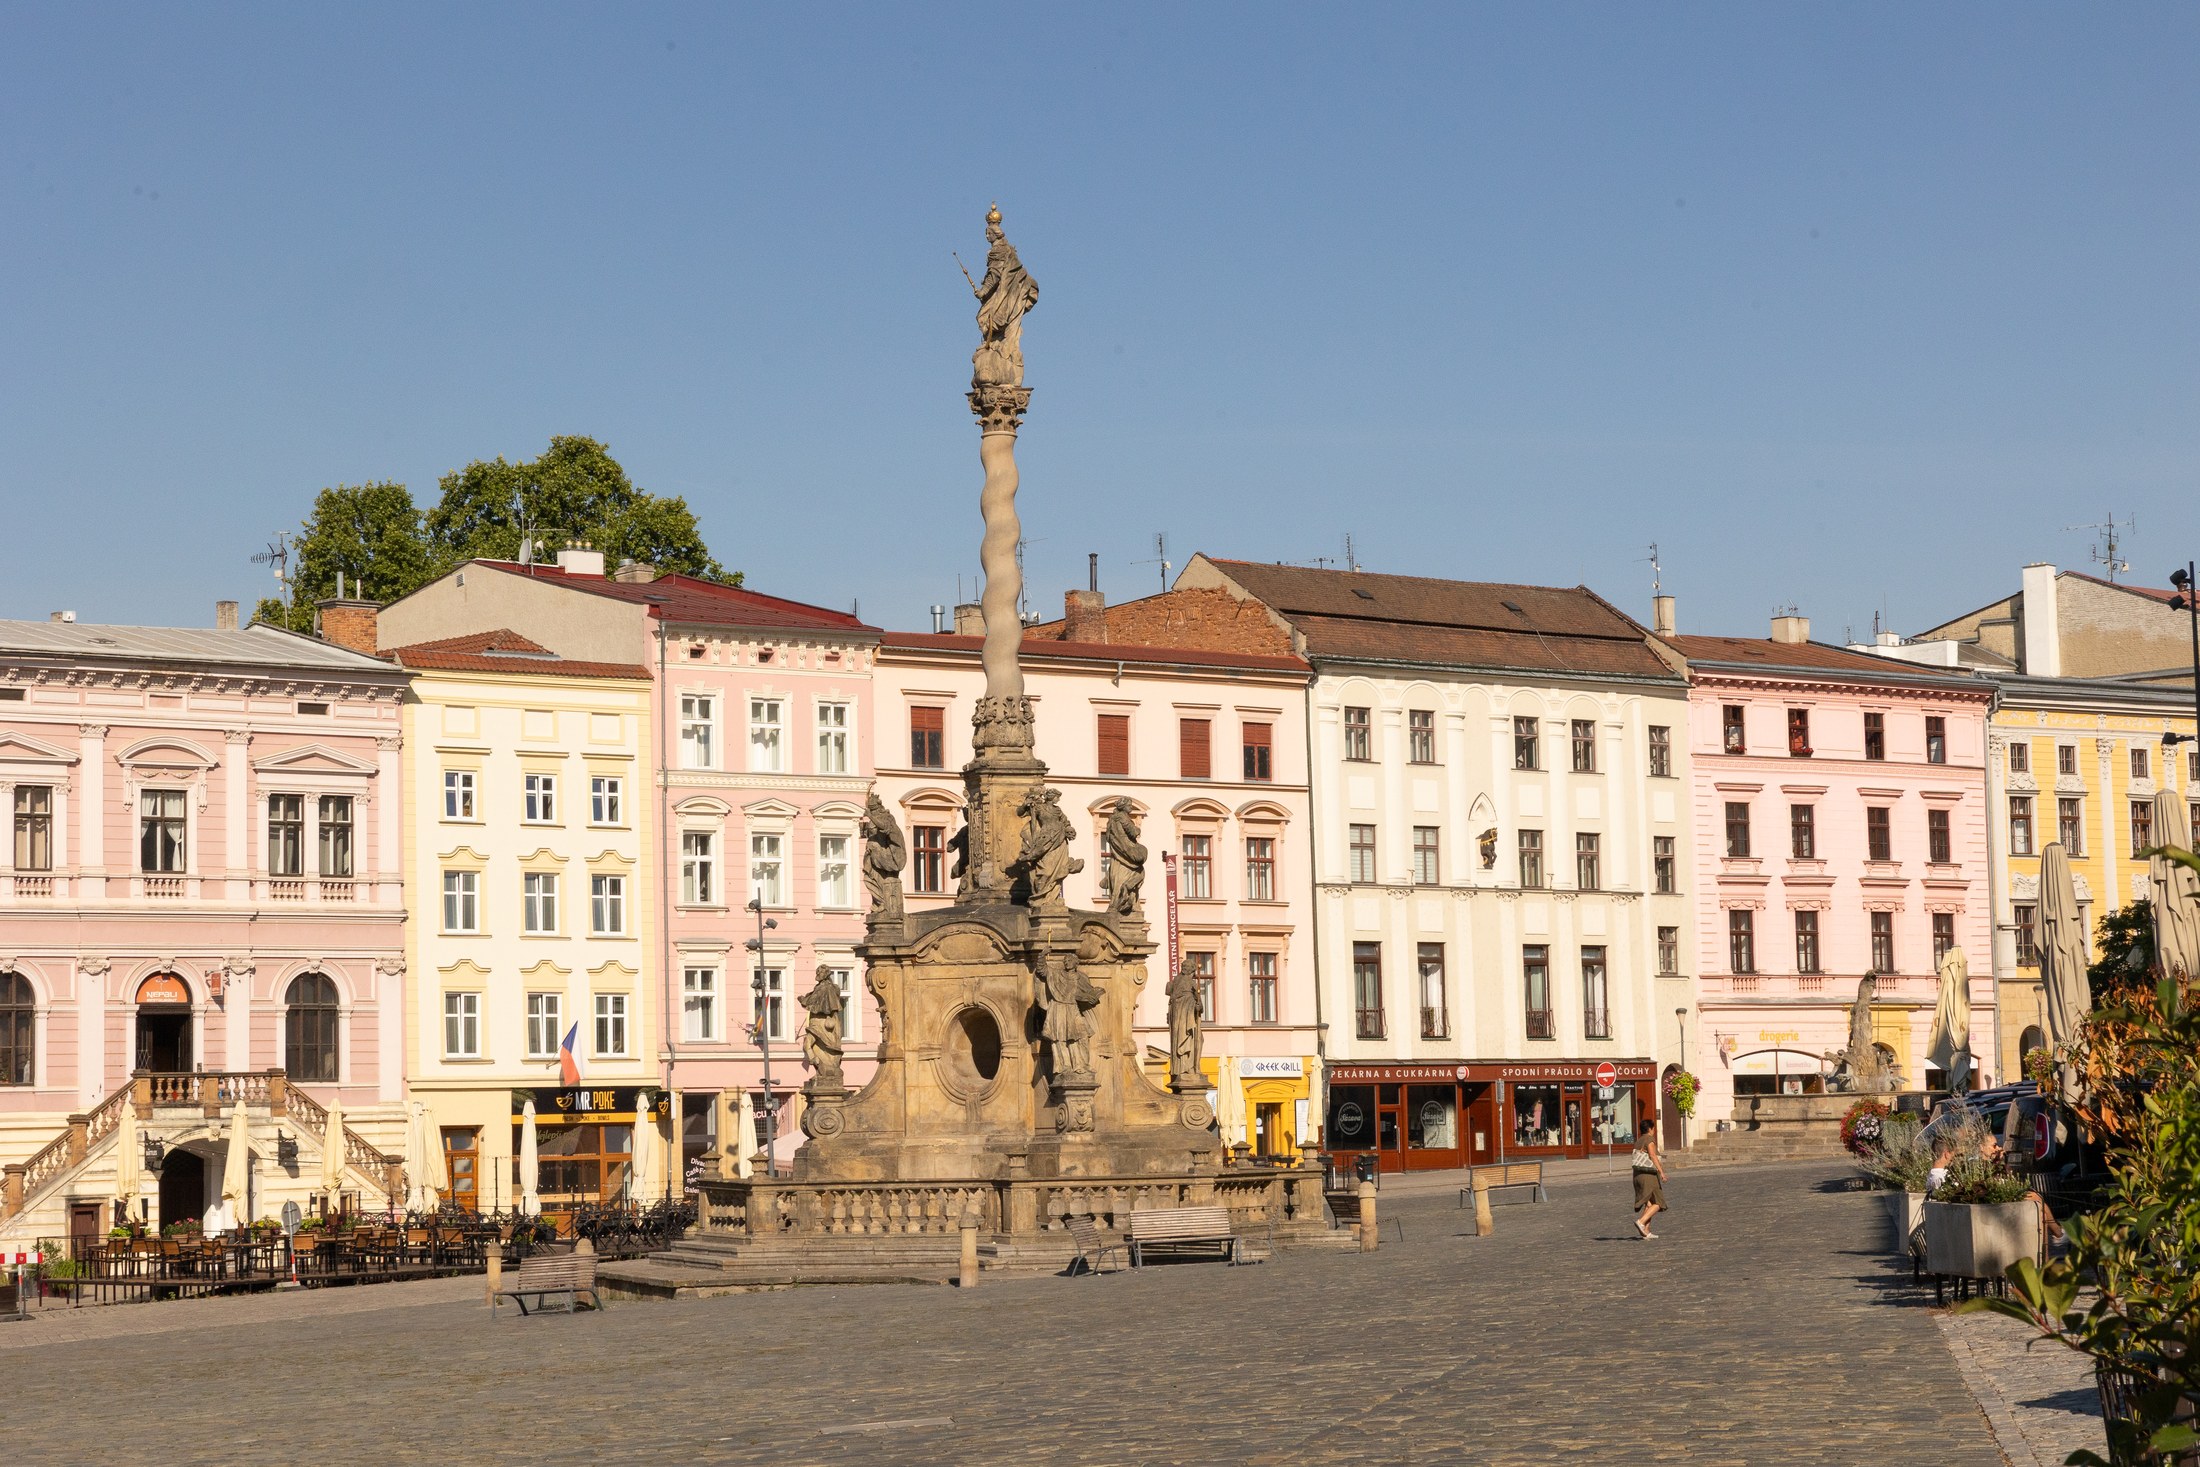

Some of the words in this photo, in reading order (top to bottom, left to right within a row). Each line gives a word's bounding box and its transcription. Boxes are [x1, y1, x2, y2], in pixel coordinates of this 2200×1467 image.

[146, 991, 178, 999] NEPALI
[1759, 1029, 1800, 1045] drogerie
[1255, 1062, 1280, 1072] GREEK
[1280, 1062, 1302, 1072] GRILL
[1330, 1068, 1380, 1079] PEKÁRNA
[1384, 1068, 1391, 1078] &
[1395, 1067, 1453, 1078] CUKRÁRNA
[1502, 1066, 1540, 1077] SPODNÍ
[1544, 1065, 1583, 1077] PRÁDLO
[1586, 1067, 1593, 1076] &
[1617, 1066, 1650, 1076] ČOCHY
[575, 1091, 593, 1110] MR.
[593, 1090, 616, 1110] POKE
